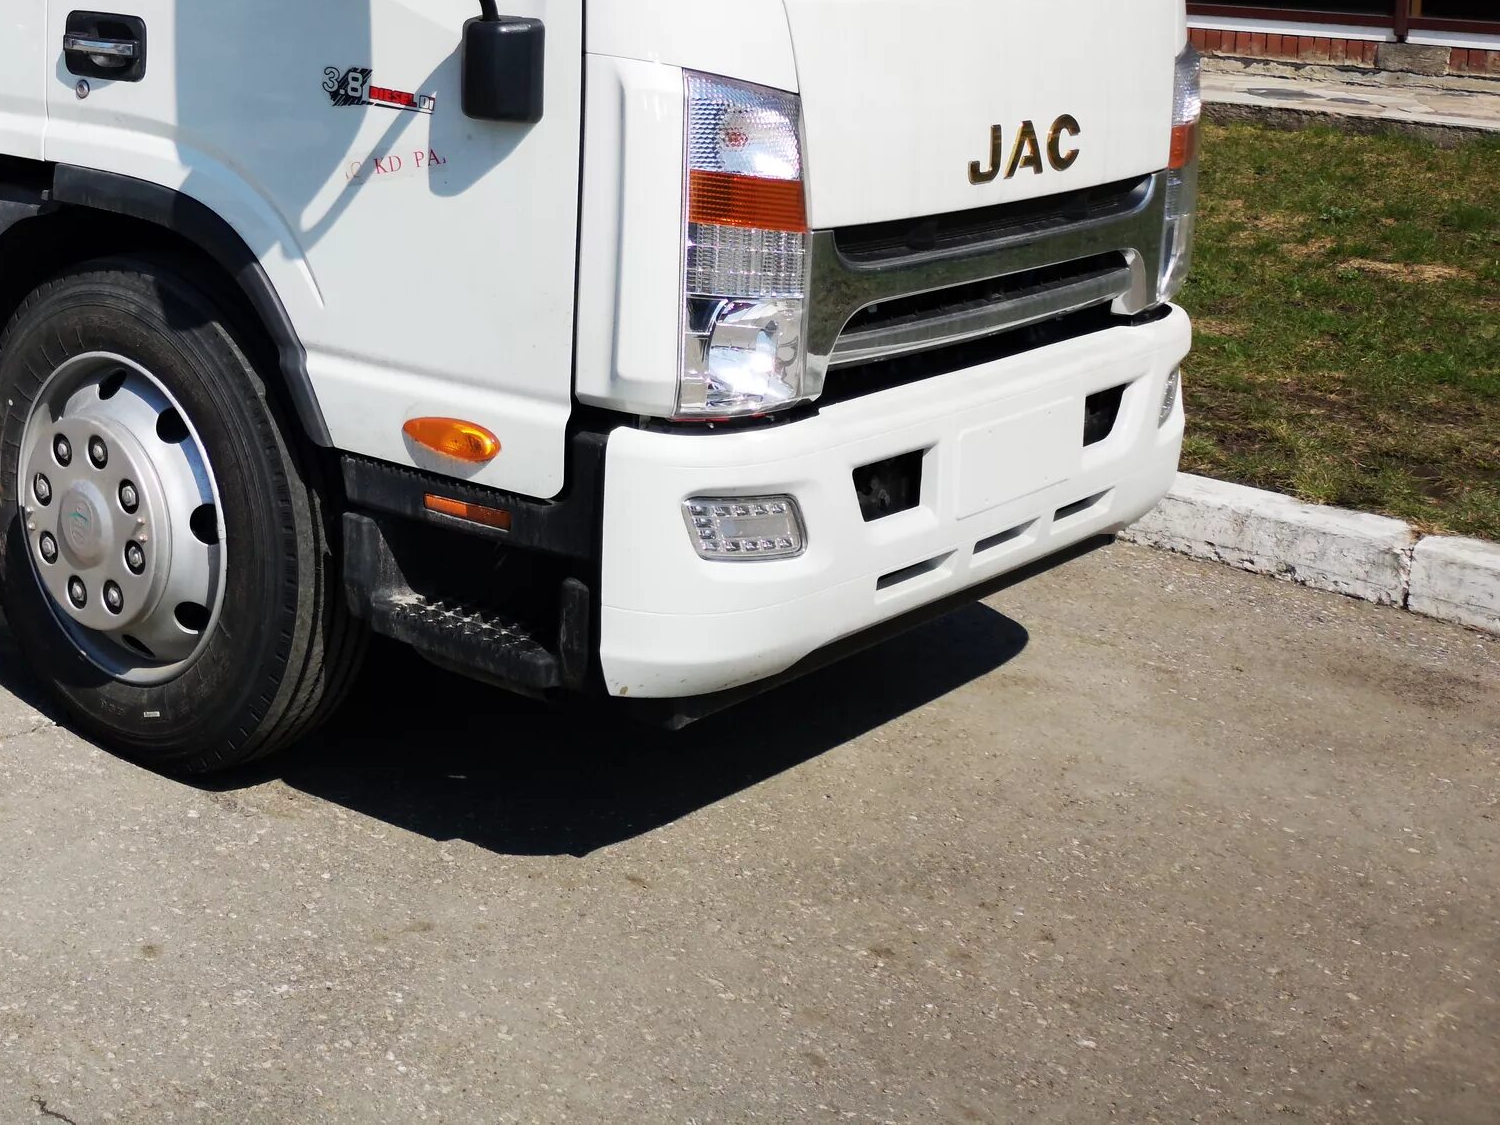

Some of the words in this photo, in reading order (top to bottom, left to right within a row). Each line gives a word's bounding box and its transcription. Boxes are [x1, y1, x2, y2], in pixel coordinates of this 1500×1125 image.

[322, 66, 363, 98] 3.8
[413, 149, 447, 168] PA
[968, 114, 1081, 185] JAC
